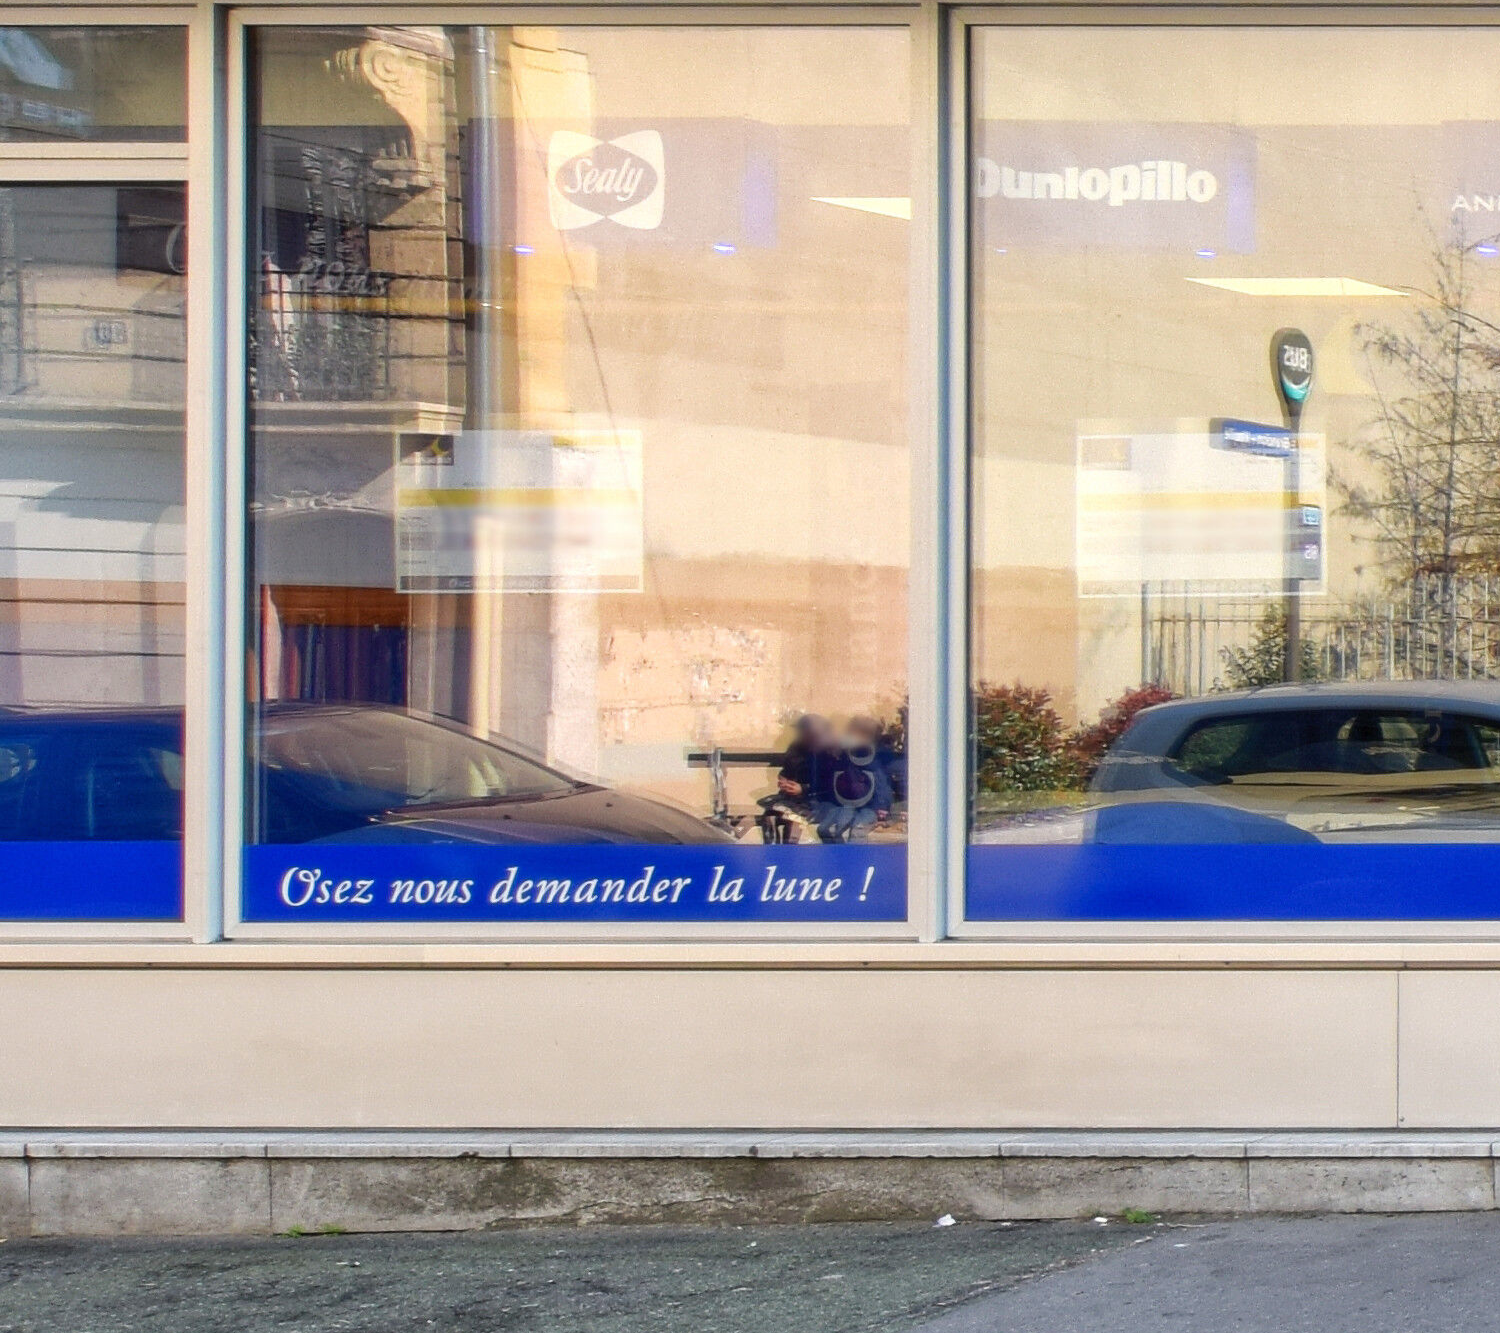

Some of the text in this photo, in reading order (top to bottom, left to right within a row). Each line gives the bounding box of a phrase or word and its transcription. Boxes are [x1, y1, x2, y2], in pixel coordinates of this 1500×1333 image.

[563, 158, 644, 202] Sealy
[974, 158, 1217, 207] Dunlopillo
[279, 865, 875, 907] Osez nous demander la lune !
